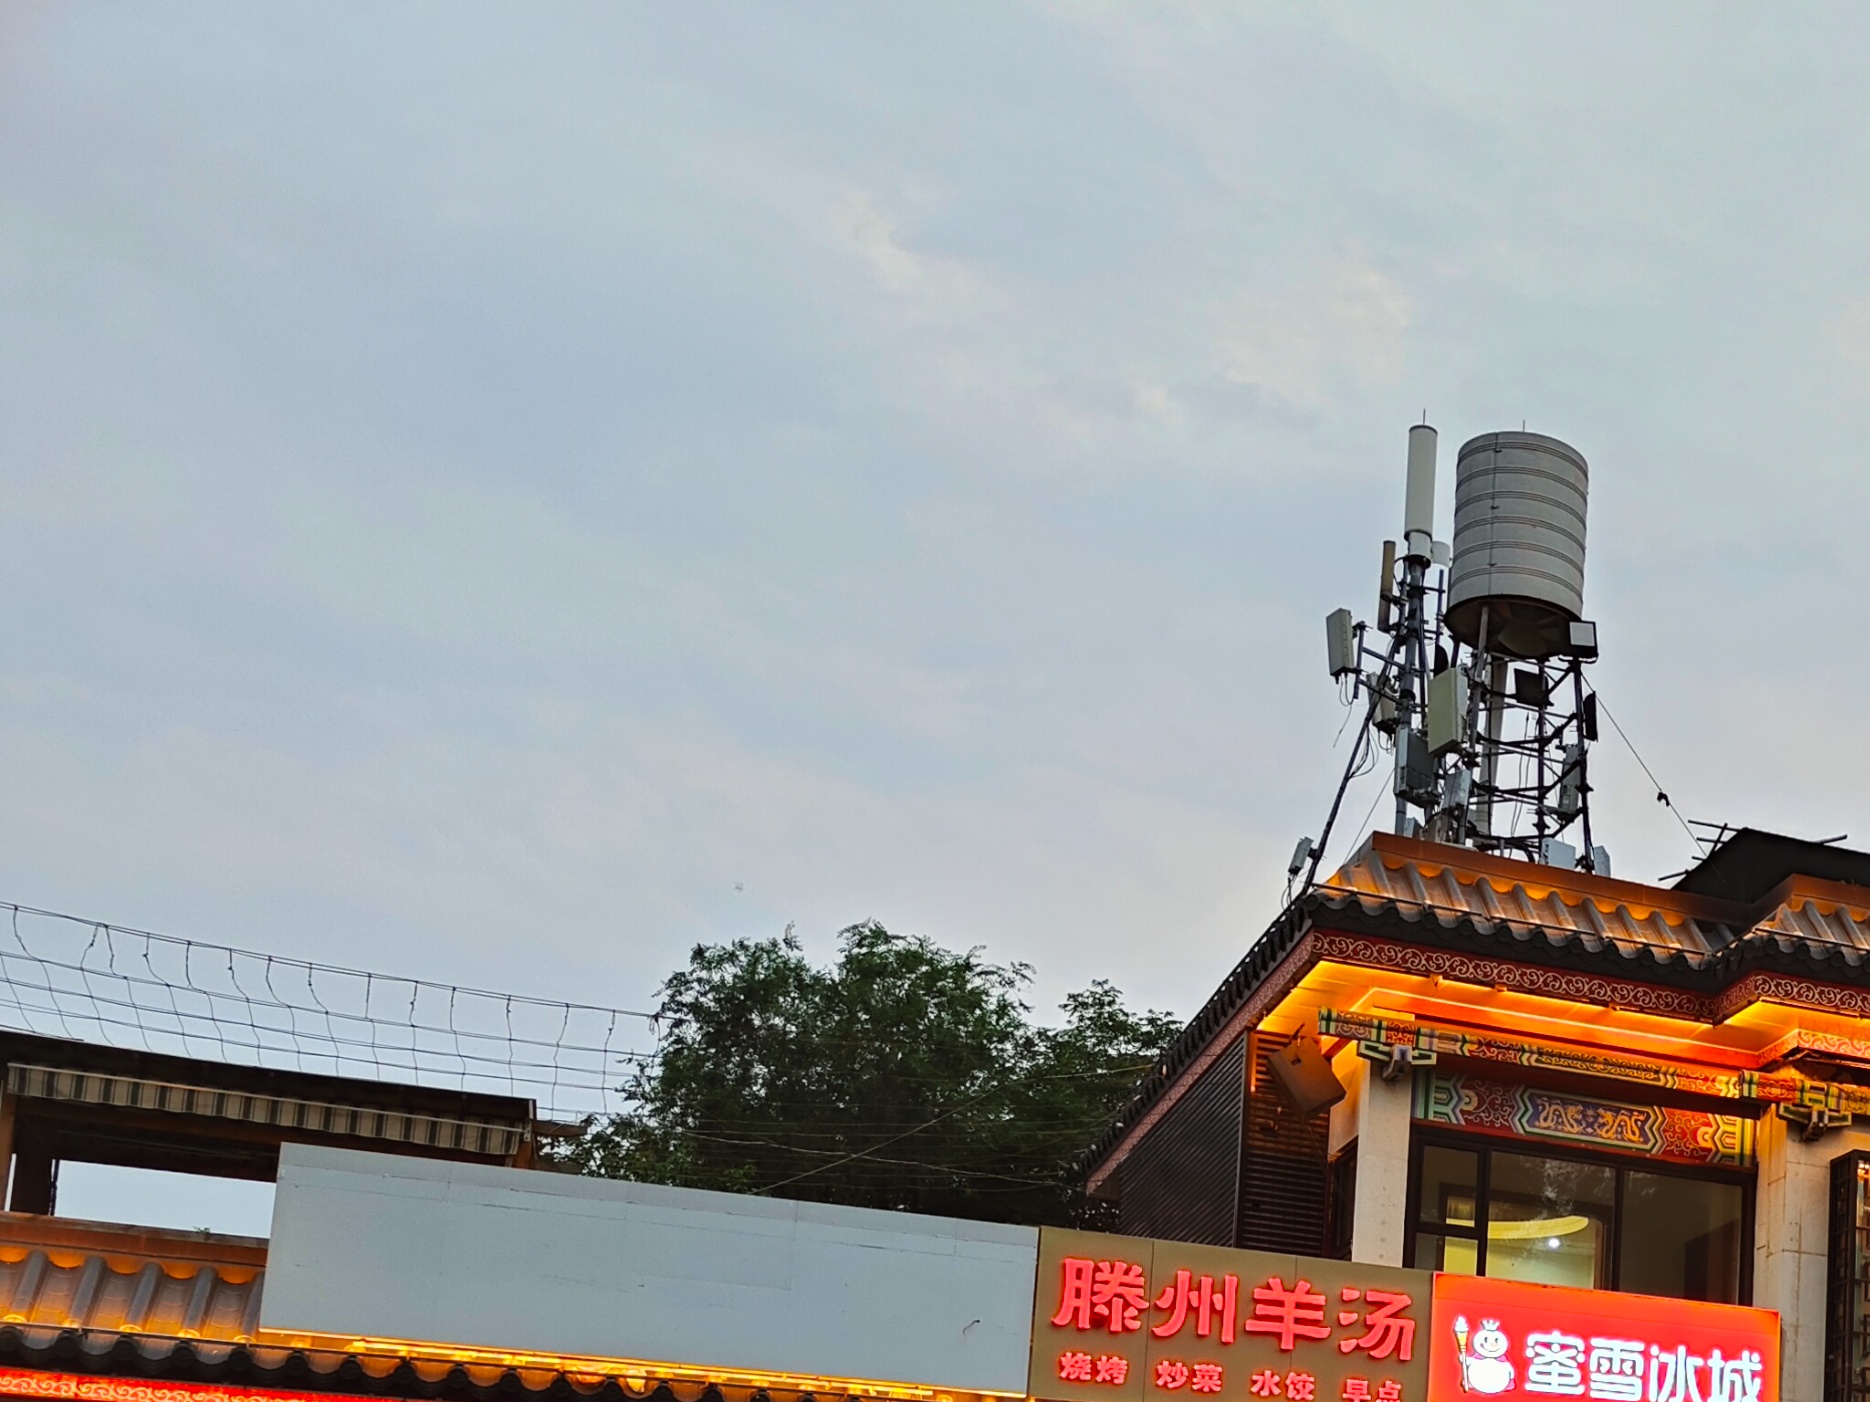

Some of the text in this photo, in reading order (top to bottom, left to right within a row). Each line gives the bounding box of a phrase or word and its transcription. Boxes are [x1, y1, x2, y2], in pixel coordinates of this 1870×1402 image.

[1052, 1258, 1415, 1362] 滕州羊汤
[1058, 1351, 1128, 1386] 烧烤
[1154, 1359, 1223, 1395] 炒菜
[1250, 1369, 1316, 1402] 水饺
